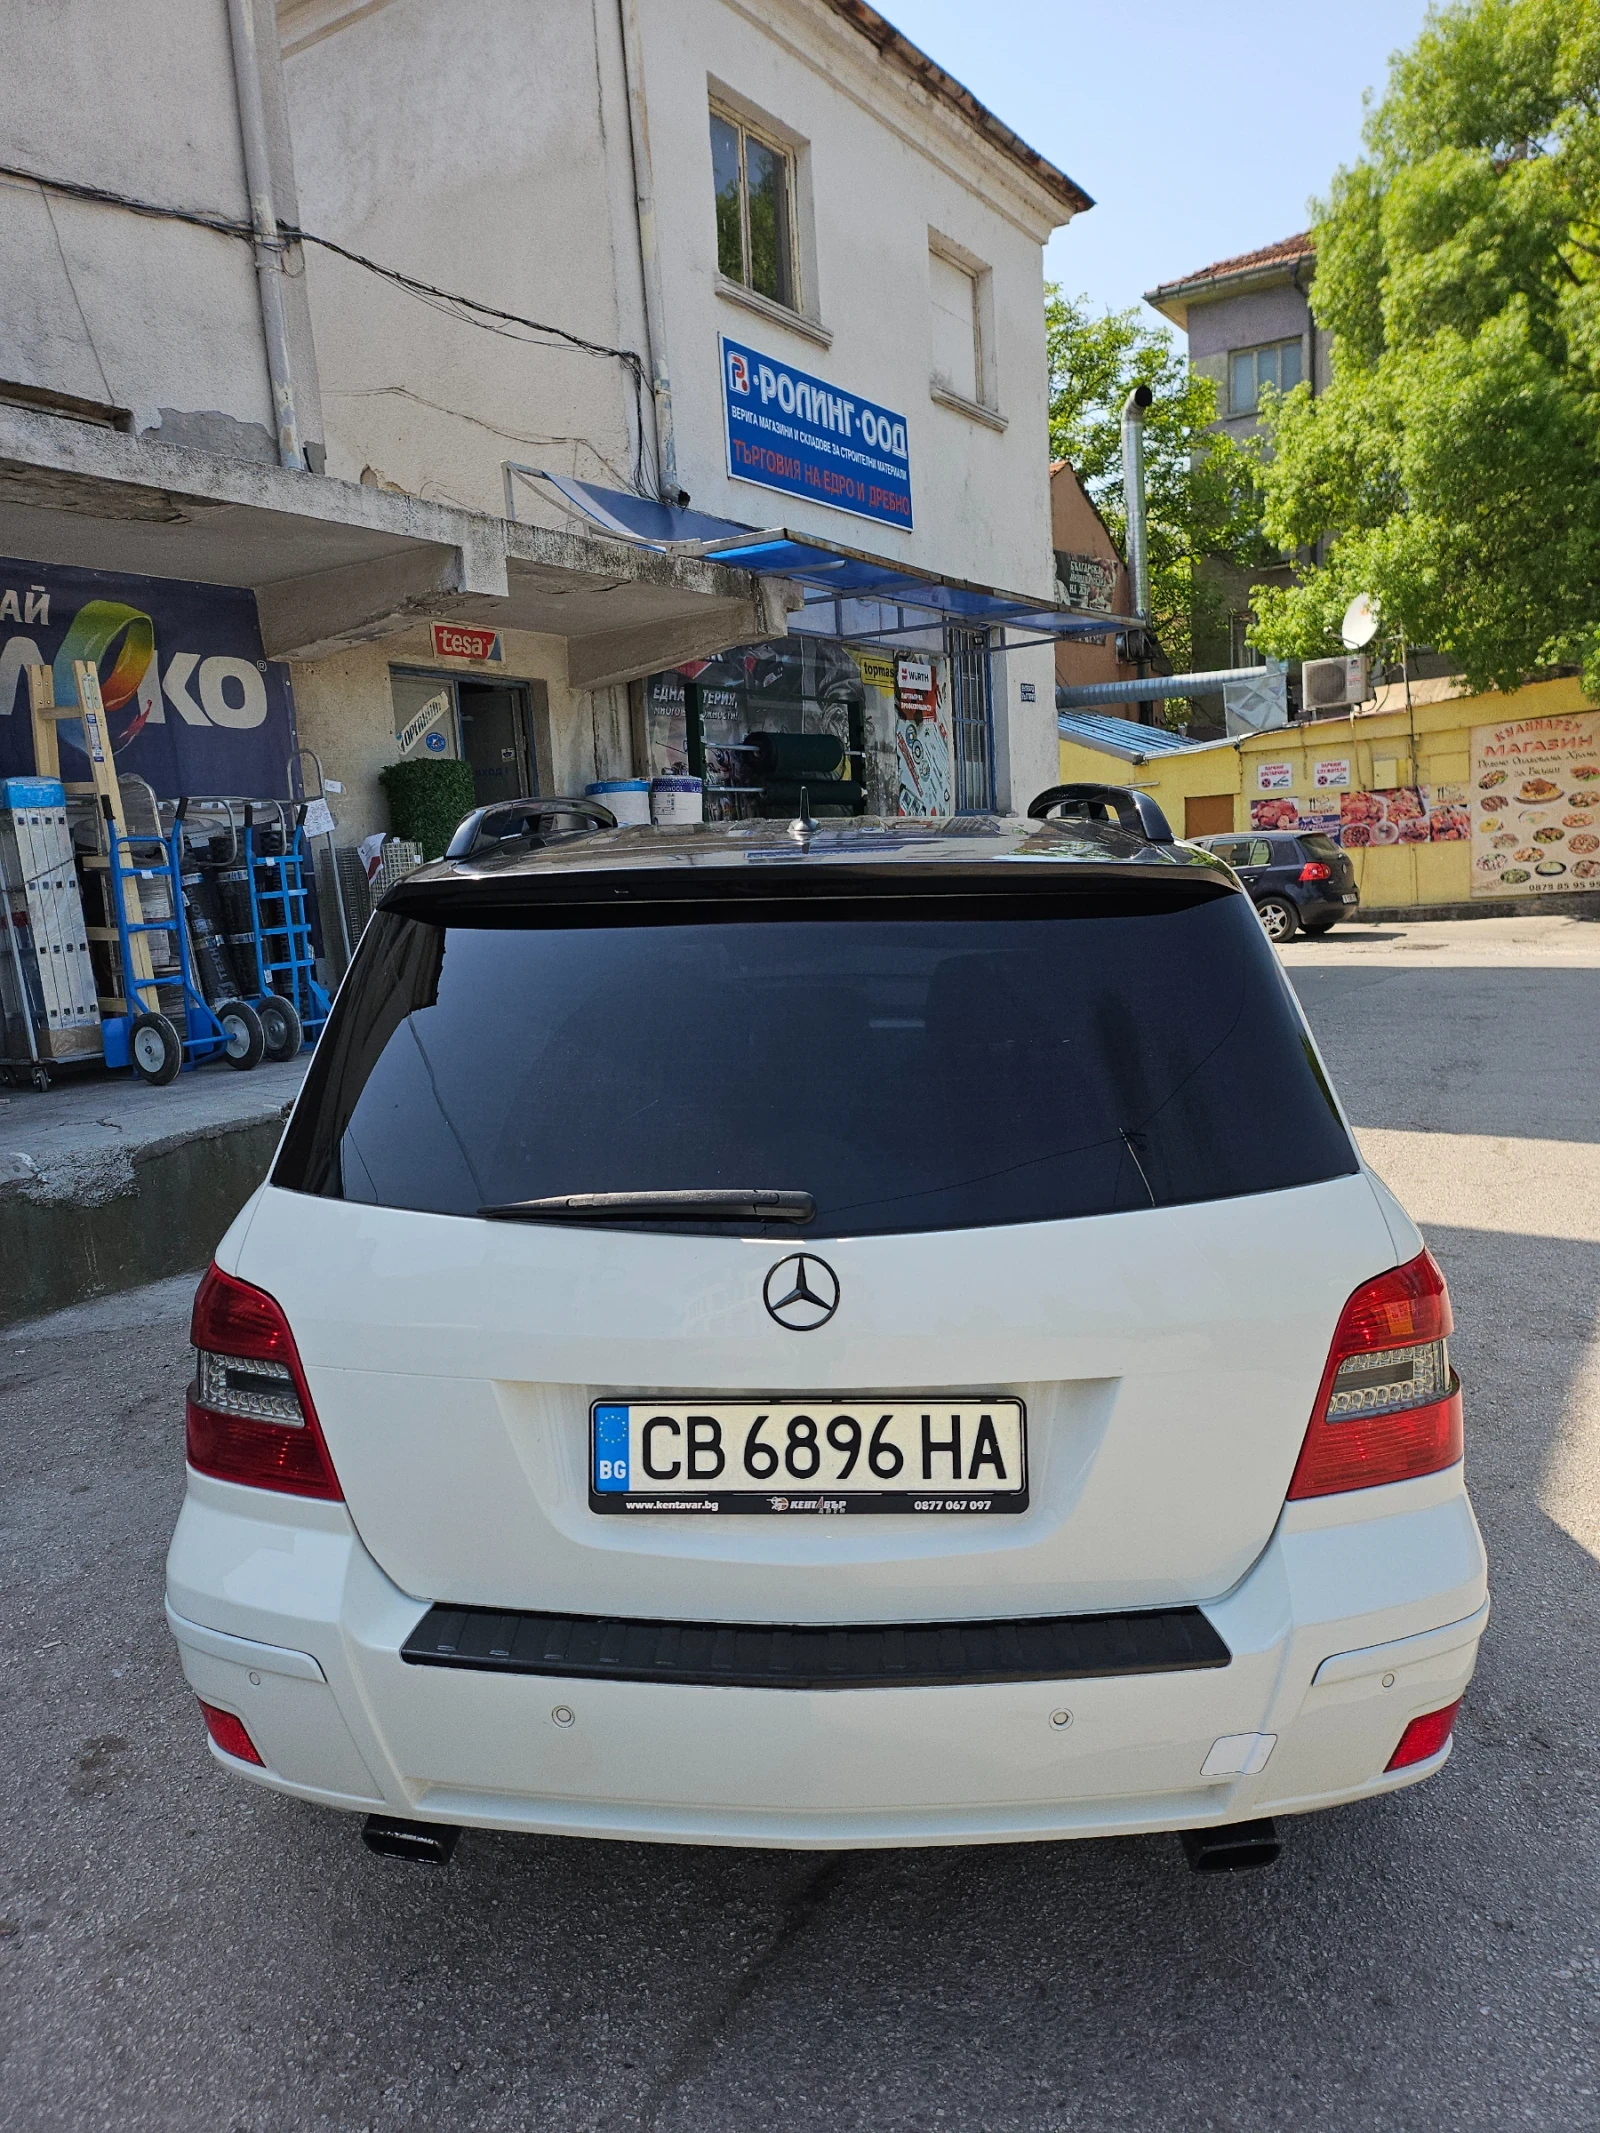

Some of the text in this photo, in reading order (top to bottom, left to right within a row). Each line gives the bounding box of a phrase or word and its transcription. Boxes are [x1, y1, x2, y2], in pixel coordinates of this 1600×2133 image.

[758, 363, 908, 460] РОЛИНГ ООД
[731, 405, 908, 481] ВЕРИГА МАГАЗИНИ И СКЛАДОВЕ ЗА СТРОИТЕЛНИ МАТЕРИАЛИ
[733, 438, 910, 516] ТЪРГОВИЯ НА ЕДРО И ДРЕБНО
[438, 628, 484, 657] tesa
[653, 684, 738, 708] ЕДНА ТЕРИЯ,
[1484, 734, 1593, 757] МАГАЗИН
[641, 1414, 1008, 1480] CB 6896 HA
[599, 1460, 627, 1480] BG
[625, 1500, 719, 1511] www.kentavar.bg
[914, 1500, 992, 1511] 0877 067 097
